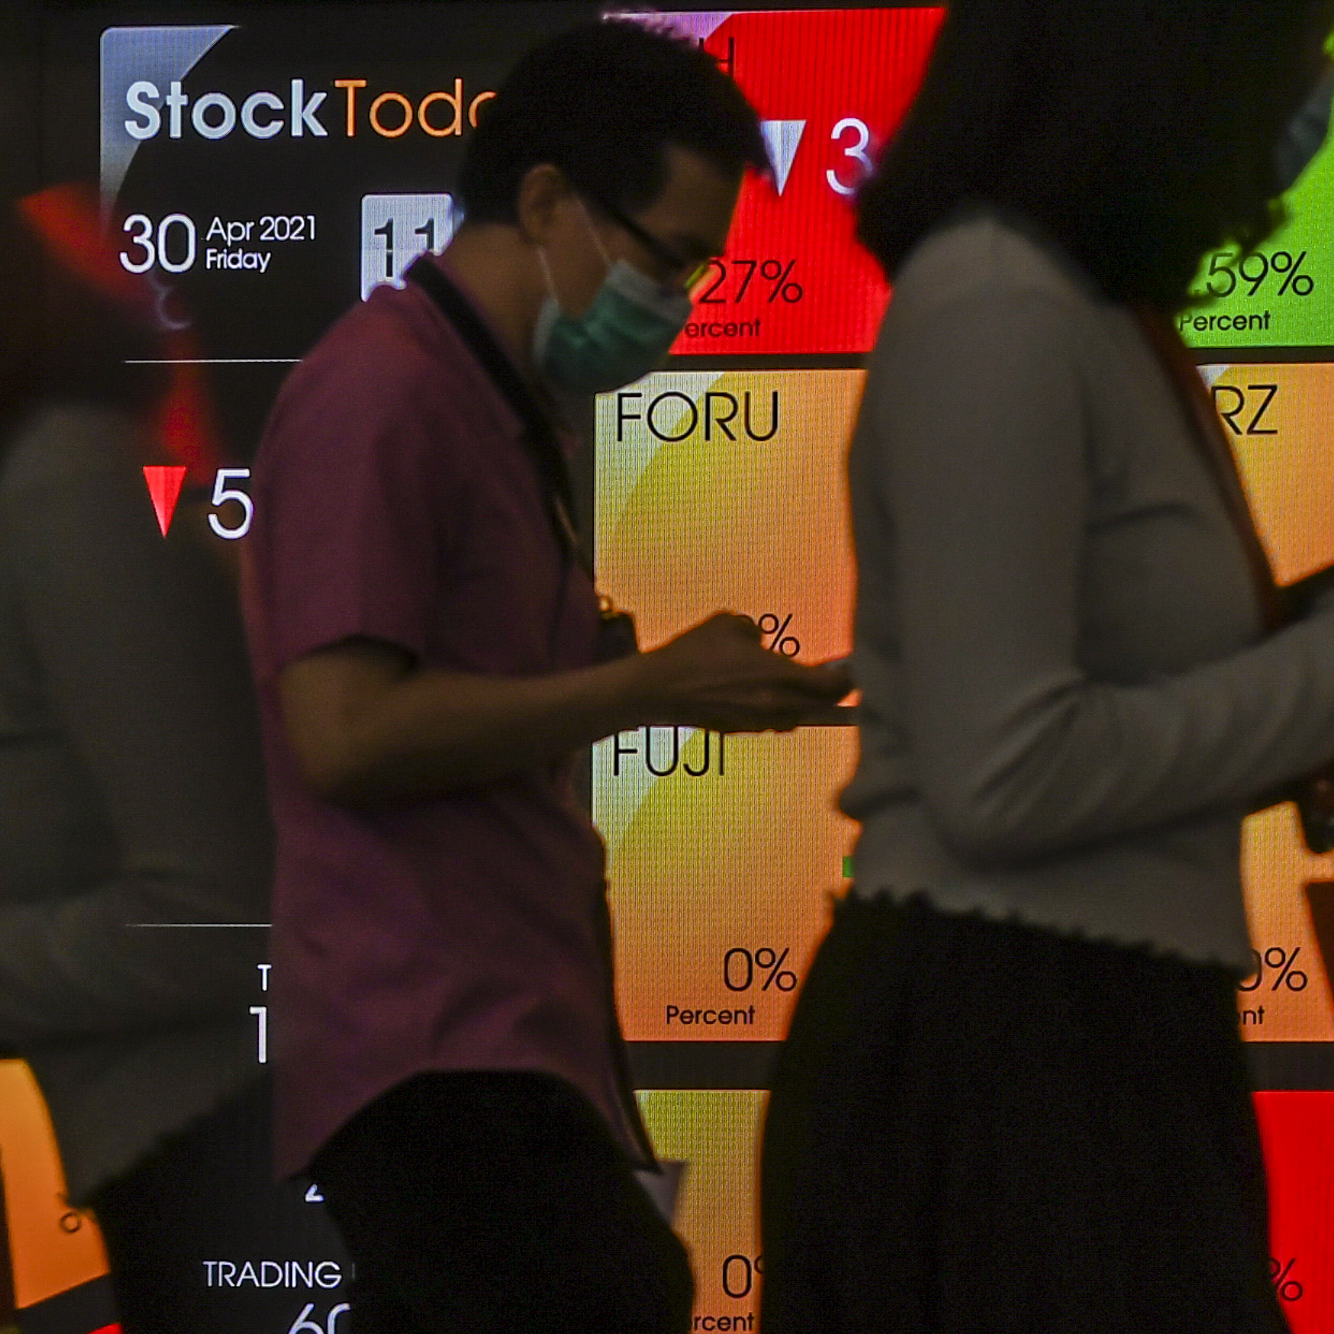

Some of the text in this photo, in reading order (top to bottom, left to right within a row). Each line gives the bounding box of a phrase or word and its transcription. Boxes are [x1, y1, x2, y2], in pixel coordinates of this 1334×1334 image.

[826, 117, 875, 196] 3
[120, 213, 196, 274] 30
[205, 215, 317, 246] Apr 2021
[205, 247, 272, 274] Friday
[685, 318, 761, 339] ercent
[1179, 309, 1271, 332] Percent
[616, 391, 780, 442] FORU
[1214, 384, 1279, 436] RZ
[613, 726, 725, 777] FUJI
[723, 947, 798, 992] 0%
[666, 1005, 756, 1026] Percent
[202, 1260, 343, 1289] TRADING
[689, 1312, 755, 1333] rcent
